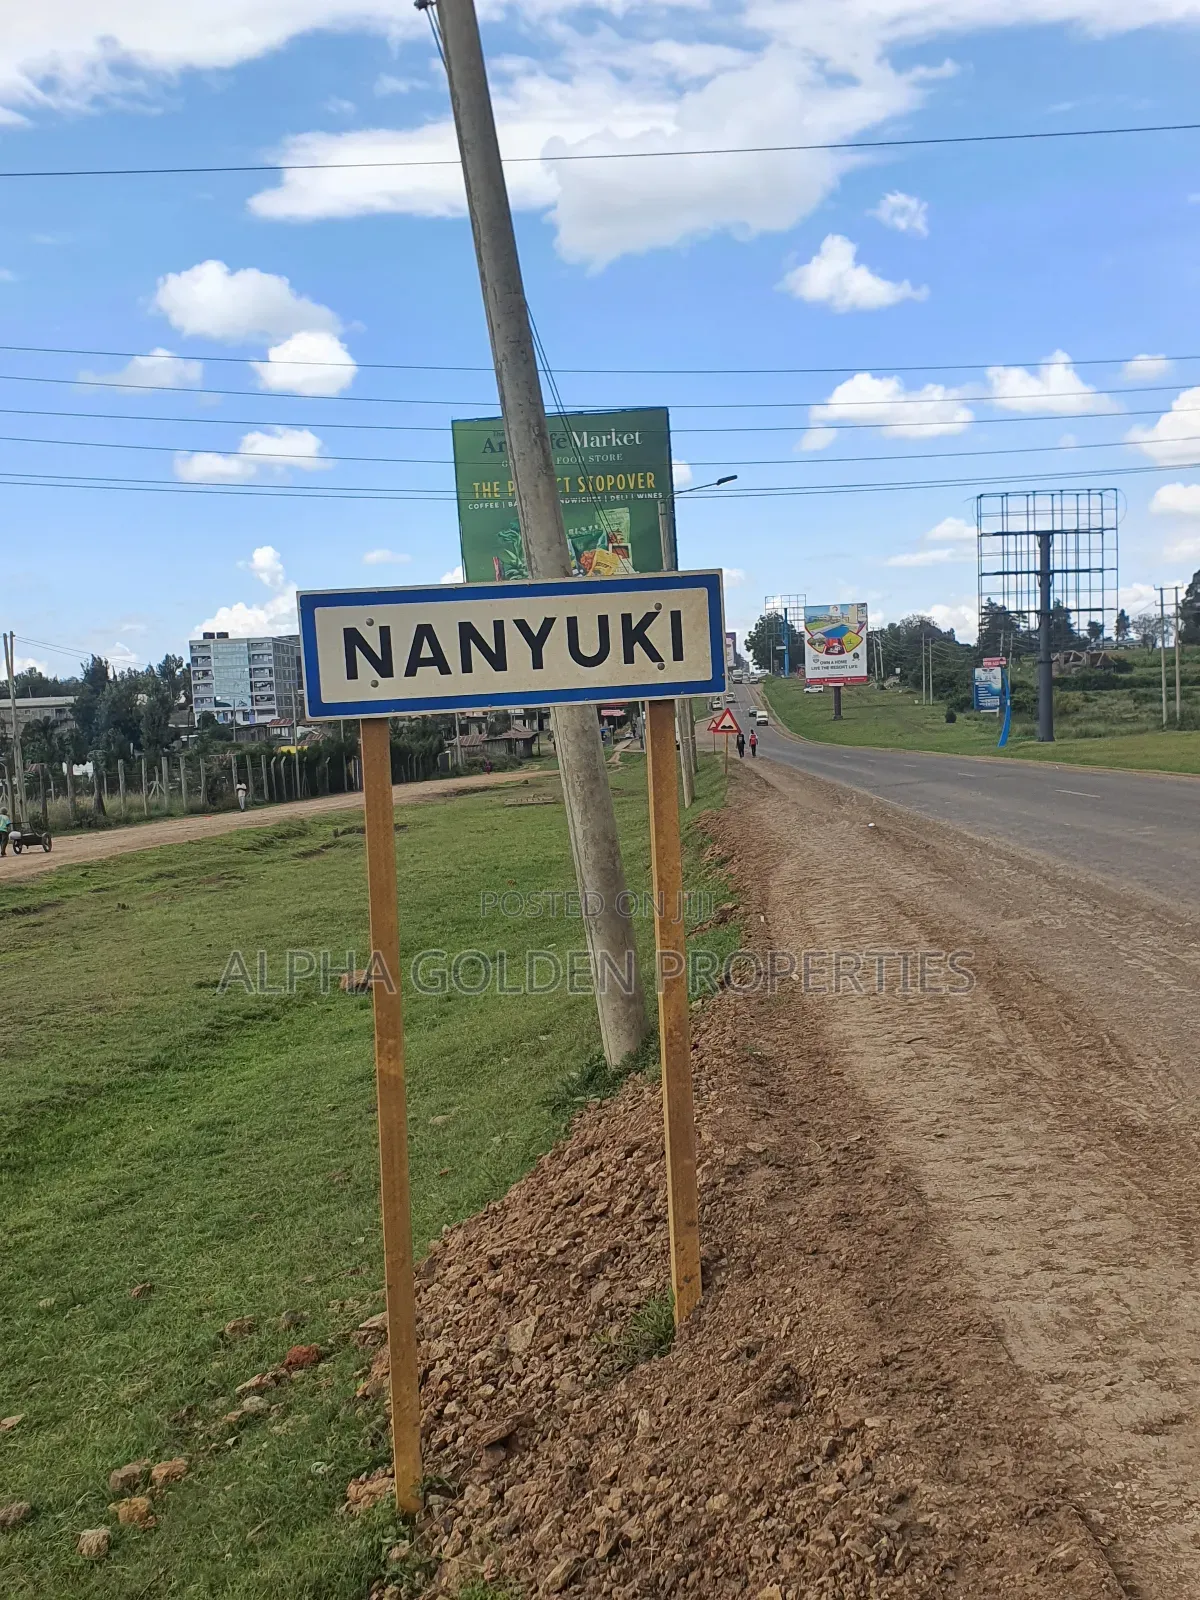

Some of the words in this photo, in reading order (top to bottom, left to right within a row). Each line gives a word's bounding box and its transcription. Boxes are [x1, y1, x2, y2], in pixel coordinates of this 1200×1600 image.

[571, 428, 643, 448] Market
[556, 456, 585, 465] FOOD
[588, 454, 623, 463] STORE
[473, 481, 500, 499] THE
[577, 472, 655, 493] STOPOVER
[468, 502, 500, 510] COFFEE
[637, 492, 663, 500] WINES
[342, 609, 684, 681] NANYUKI
